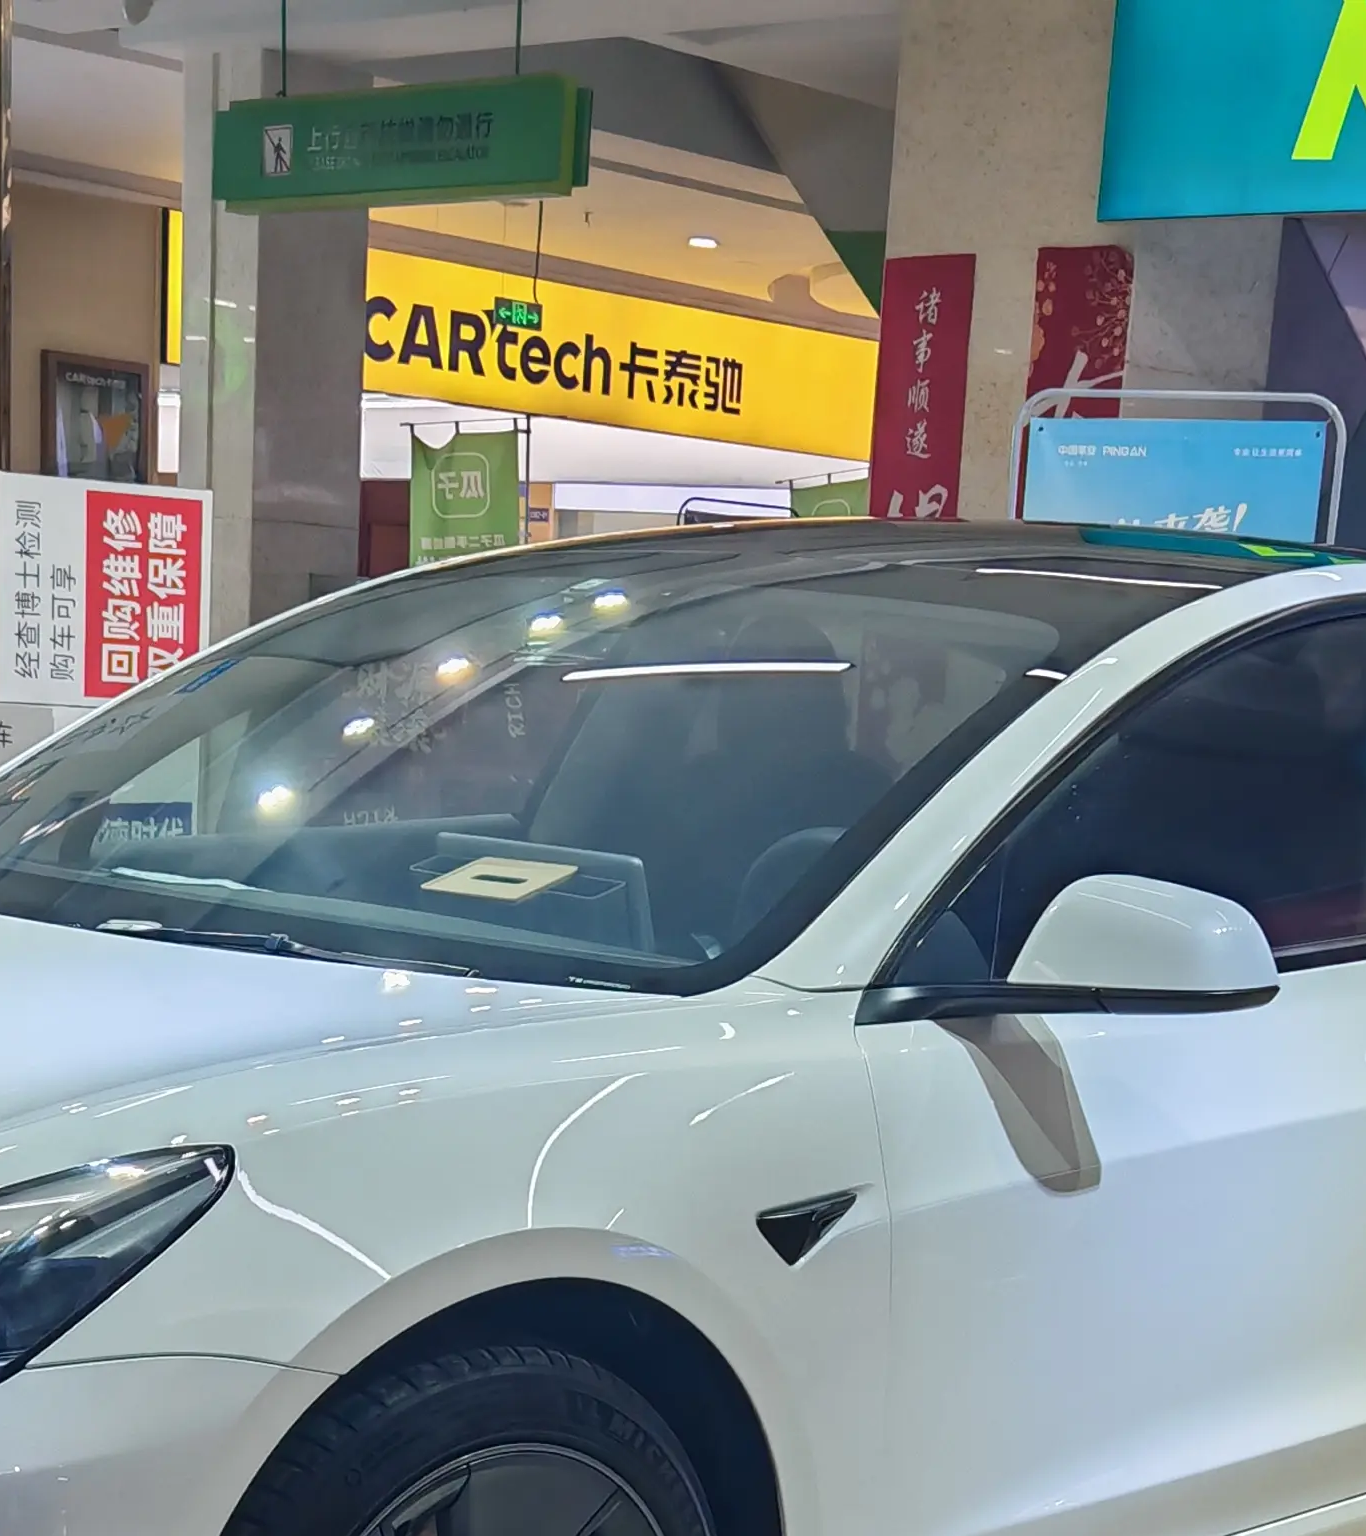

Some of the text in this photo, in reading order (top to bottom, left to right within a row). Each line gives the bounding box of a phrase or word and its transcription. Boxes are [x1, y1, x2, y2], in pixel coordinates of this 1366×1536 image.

[619, 341, 744, 416] 卡泰驰
[904, 288, 944, 460] 诸事顺遂
[14, 499, 42, 679] 经查博士检测
[49, 563, 77, 682] 购车可享
[101, 507, 144, 684] 回购维修
[146, 512, 189, 680] 双重保障
